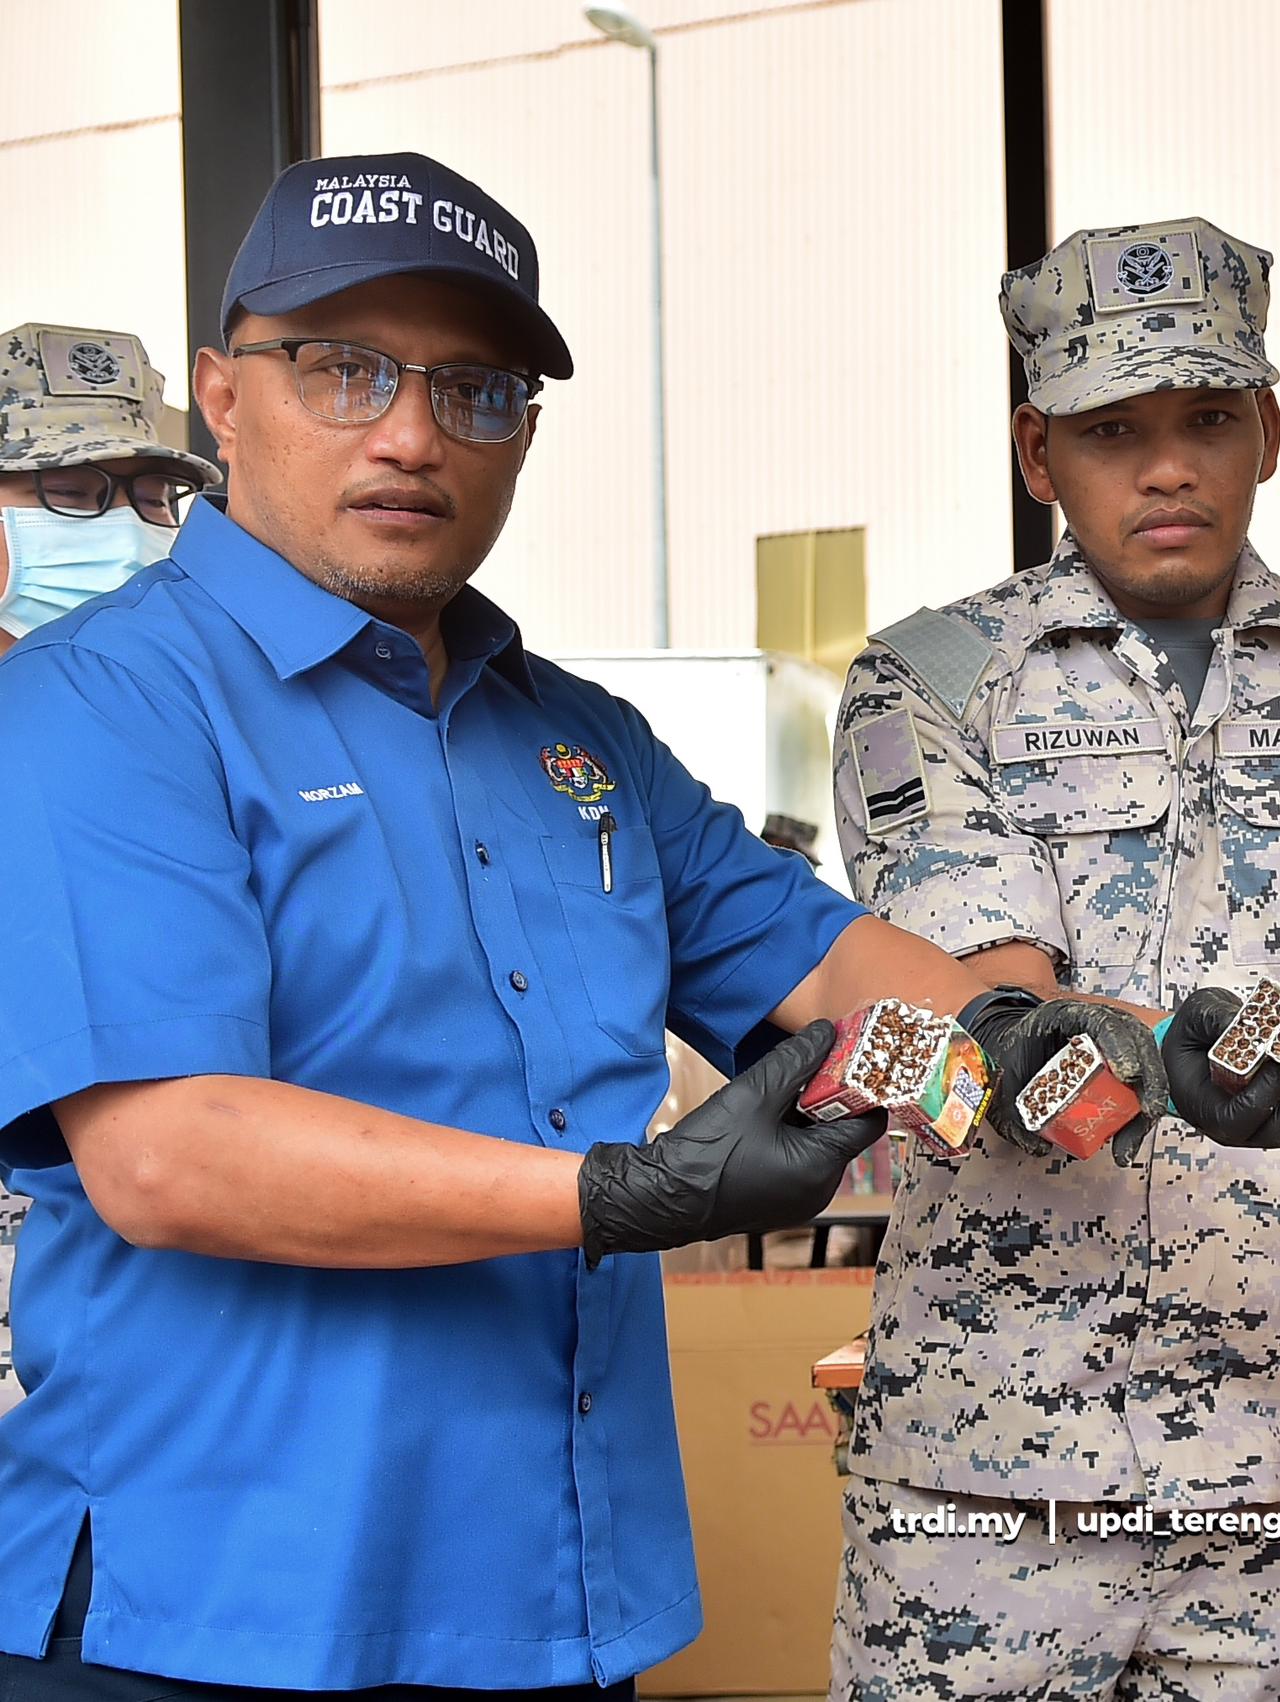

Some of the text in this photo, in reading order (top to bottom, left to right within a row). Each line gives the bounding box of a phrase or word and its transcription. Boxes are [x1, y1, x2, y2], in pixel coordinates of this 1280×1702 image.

[314, 174, 412, 191] MALAYSIA
[310, 189, 520, 281] COAST GUARD
[1024, 727, 1141, 752] RIZUWAN
[298, 782, 364, 802] NORZAM
[972, 1087, 993, 1127] WARNING
[1072, 1095, 1118, 1137] SAAT
[749, 1401, 843, 1438] SAA
